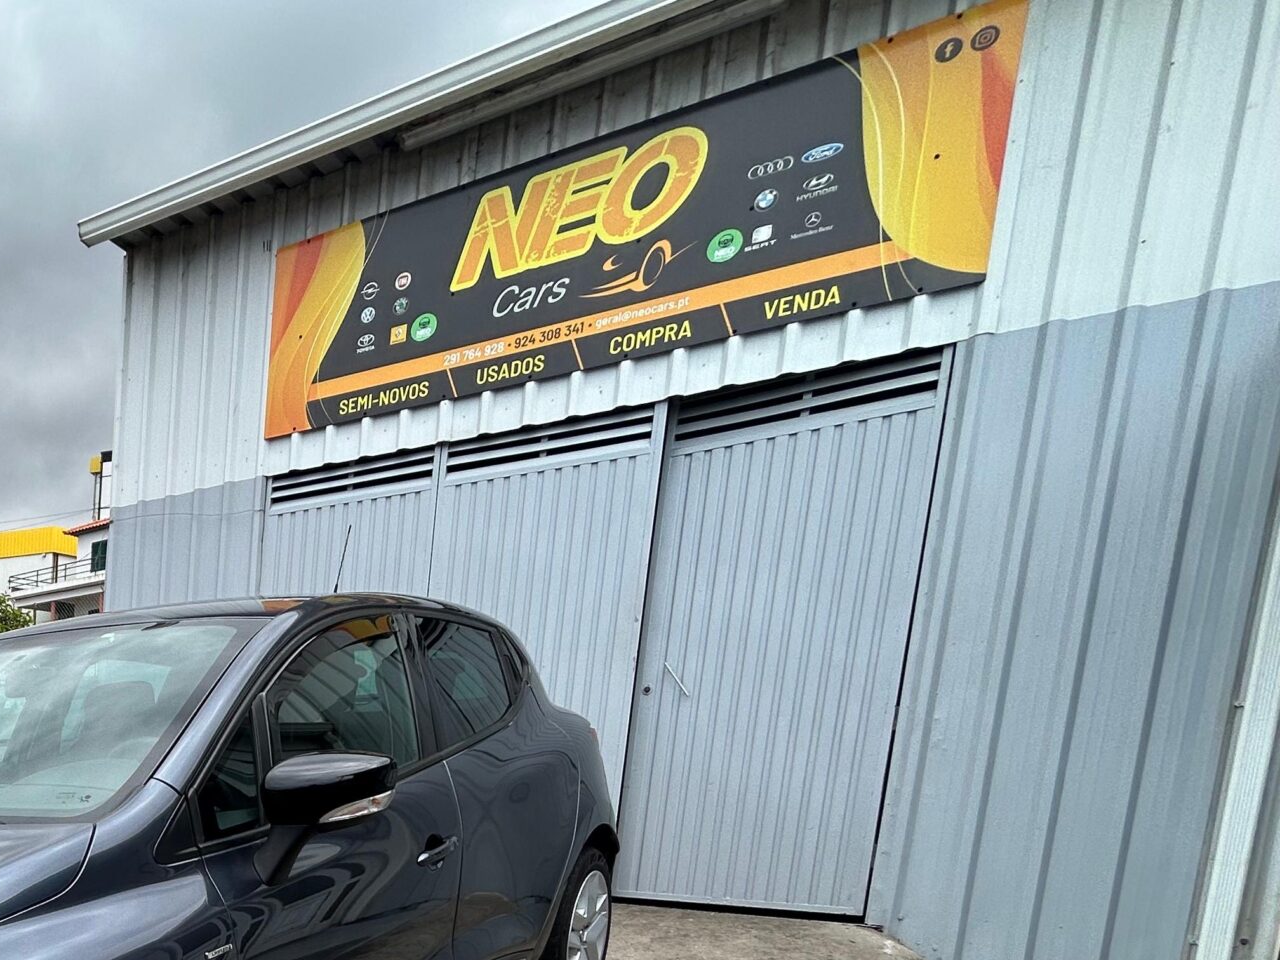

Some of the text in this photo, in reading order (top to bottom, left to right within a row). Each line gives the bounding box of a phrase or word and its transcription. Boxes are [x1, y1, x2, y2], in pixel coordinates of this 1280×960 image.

[450, 126, 708, 292] NEO
[796, 185, 839, 202] HYUNDAI
[744, 239, 777, 252] SEAT
[492, 277, 570, 318] Cars
[764, 285, 841, 320] VENDA
[443, 296, 690, 367] 291 764 928 924 308 341 geral@neocars.pt
[609, 320, 692, 355] COMPRA
[476, 354, 545, 385] USADOS
[339, 381, 430, 415] SEMI-NOVOS
